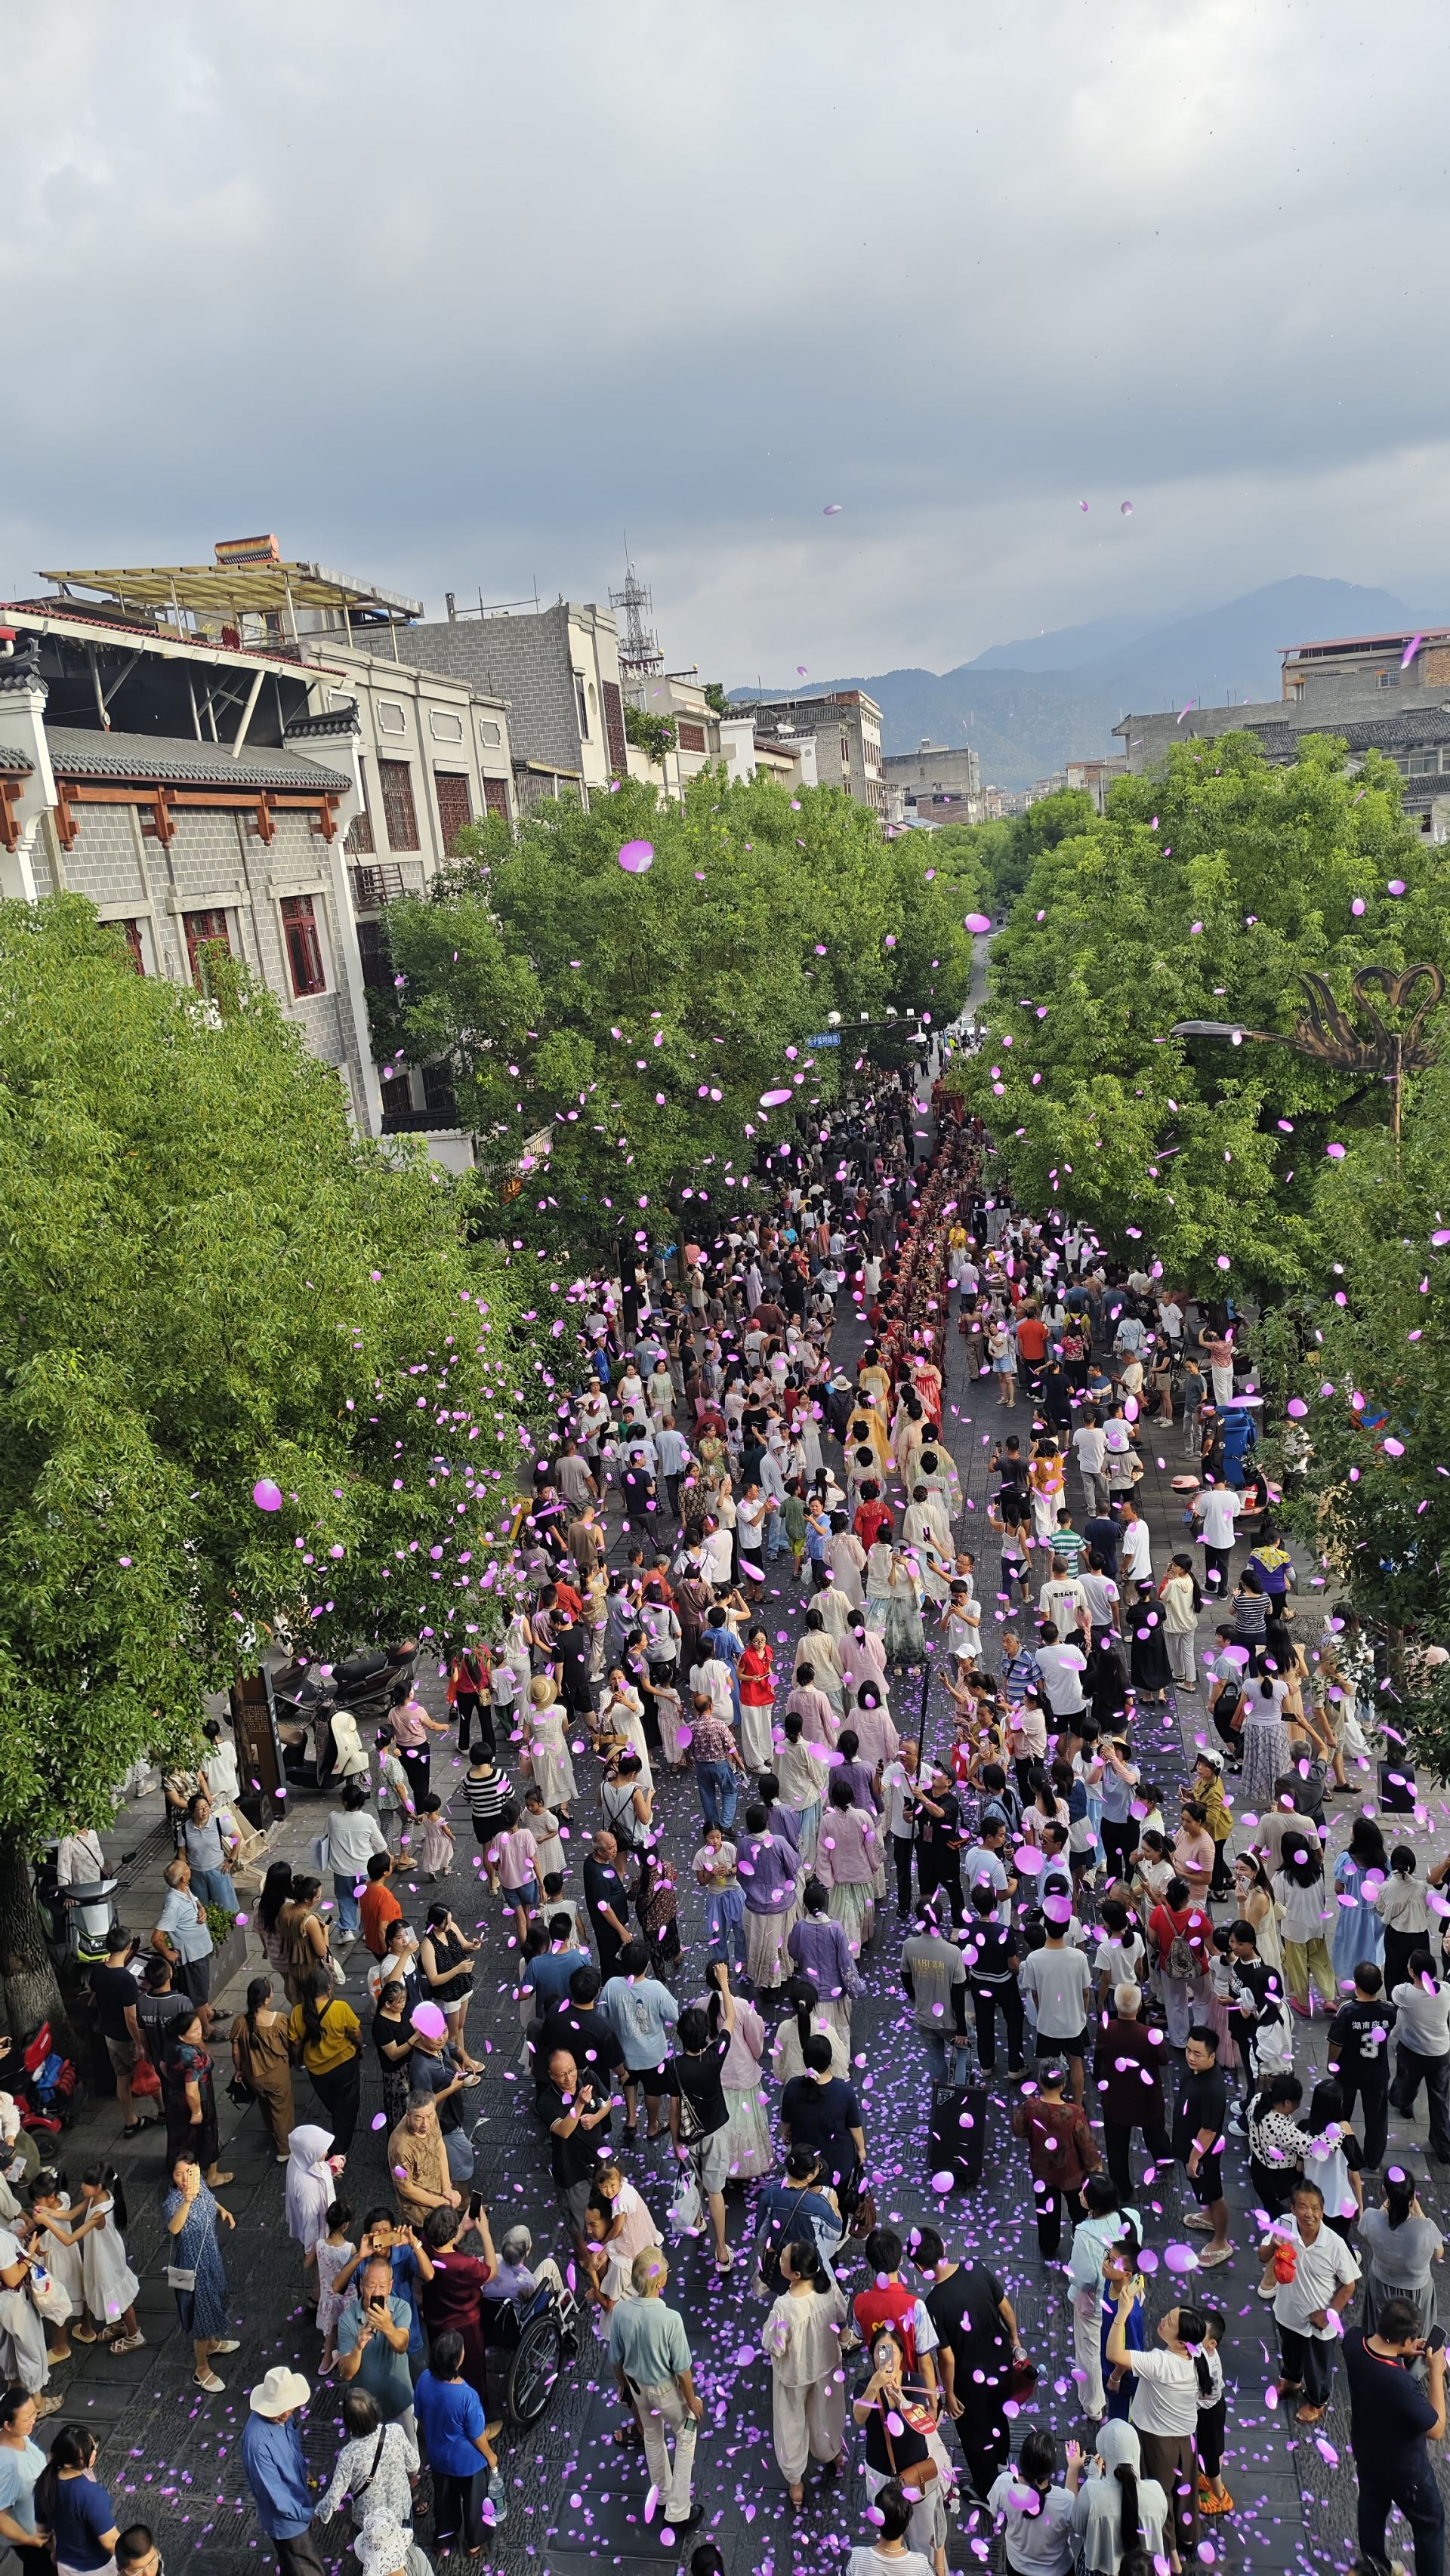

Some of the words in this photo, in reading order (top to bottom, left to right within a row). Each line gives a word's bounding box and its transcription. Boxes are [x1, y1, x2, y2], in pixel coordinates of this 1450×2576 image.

[1352, 2020, 1390, 2030] 湖南应急
[1359, 2032, 1379, 2059] 3
